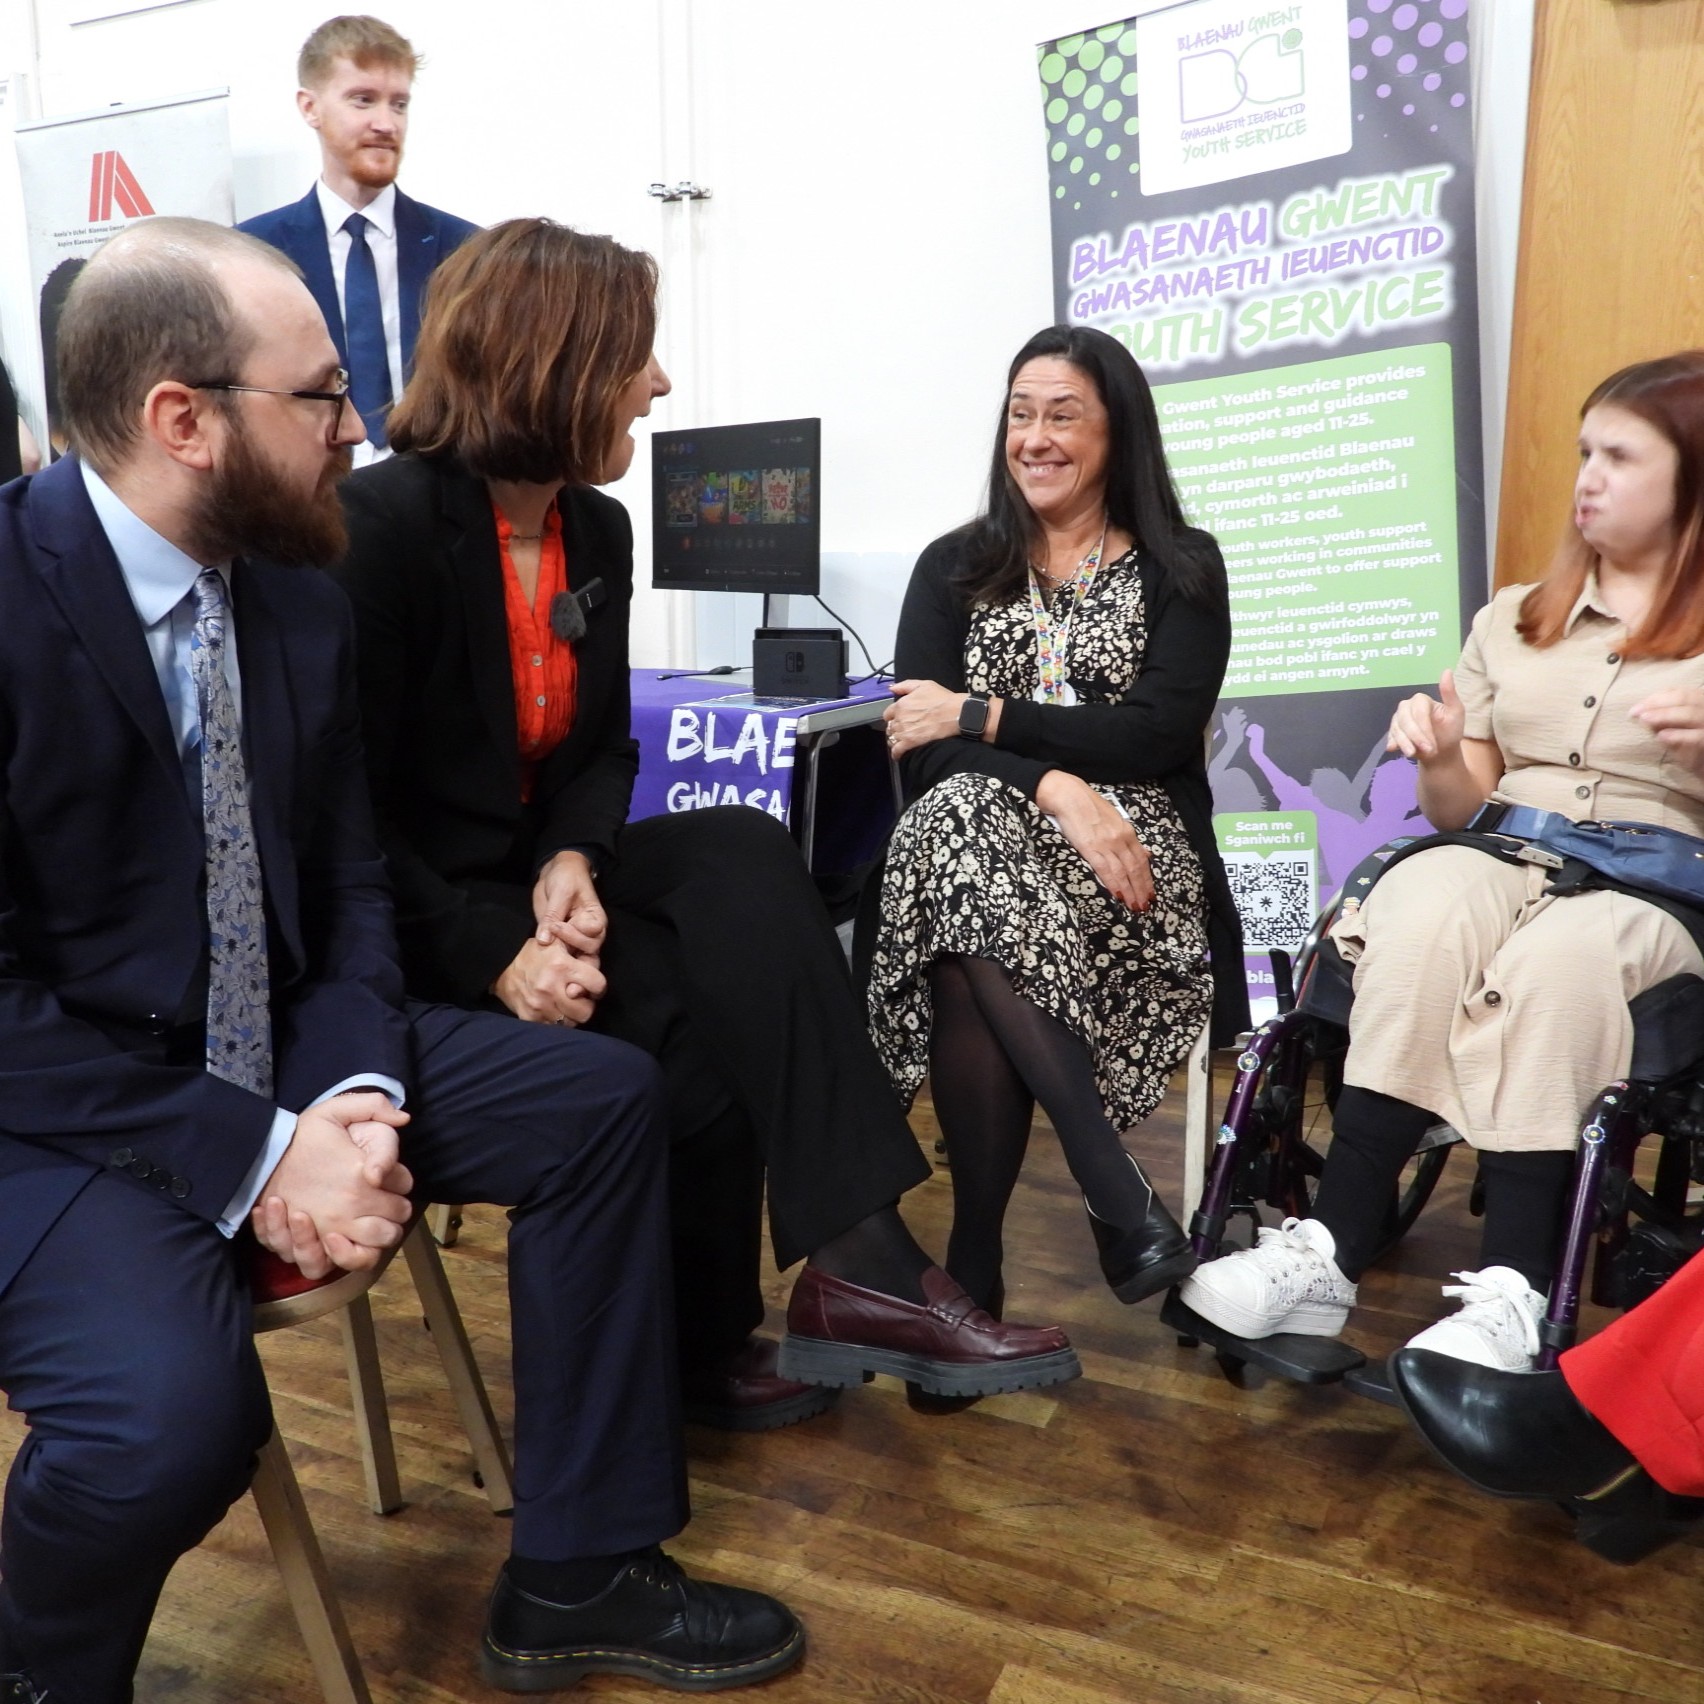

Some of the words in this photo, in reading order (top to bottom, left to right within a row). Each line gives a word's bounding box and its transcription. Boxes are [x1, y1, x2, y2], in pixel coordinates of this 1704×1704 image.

[1178, 20, 1244, 51] BLAENAU
[1248, 6, 1302, 34] GWENT
[1180, 116, 1245, 142] GWASANAETH
[1248, 102, 1306, 126] IEUENCTID
[1182, 136, 1231, 164] YOUTH
[1235, 118, 1307, 149] SERVICE
[1072, 207, 1267, 284] BLAENAU
[1282, 170, 1448, 238] GWENT
[1073, 256, 1270, 319] GWASANAETH
[1282, 226, 1444, 281] IEUENCTID
[1109, 308, 1223, 362] OUTH
[1238, 270, 1444, 348] SERVICE
[1162, 397, 1218, 415] Gwent
[1222, 388, 1272, 407] Youth
[1276, 378, 1341, 398] Service
[1346, 366, 1426, 390] provides
[1160, 418, 1210, 434] ation,
[1214, 406, 1282, 427] support
[1286, 400, 1320, 417] and
[1323, 388, 1409, 414] guidance
[1218, 428, 1276, 449] people
[1280, 418, 1325, 438] aged
[1328, 412, 1374, 430] 11-25.
[1170, 458, 1248, 478] asanaeth
[1252, 444, 1335, 468] Ieuenctid
[1340, 436, 1415, 456] Blaenau
[1181, 484, 1202, 498] yn
[1206, 475, 1273, 493] darparu
[1278, 457, 1396, 487] gwybodaeth,
[1205, 493, 1278, 514] cymorth
[1282, 491, 1303, 503] ac
[1307, 476, 1396, 500] arweiniad
[1401, 473, 1407, 488] i
[1215, 516, 1256, 532] ifanc
[1260, 510, 1300, 526] 11-25
[1304, 504, 1343, 522] oed.
[1258, 535, 1320, 550] workers,
[1323, 528, 1365, 545] youth
[1368, 521, 1427, 538] support
[1224, 558, 1254, 569] eers
[1256, 551, 1316, 565] working
[1319, 548, 1332, 559] in
[1336, 536, 1433, 557] communities
[1228, 570, 1272, 583] laenau
[1276, 565, 1322, 579] Gwent
[1325, 563, 1341, 574] to
[1344, 560, 1380, 573] offer
[1383, 552, 1442, 569] support
[1229, 588, 1262, 599] oung
[1266, 582, 1318, 598] people.
[1230, 610, 1273, 622] ithwyr
[1277, 602, 1344, 617] ieuenctid
[1348, 597, 1412, 613] cymwys,
[1231, 622, 1294, 637] euenctid
[1297, 624, 1305, 632] a
[1309, 614, 1416, 633] gwirfoddolwyr
[1420, 611, 1439, 623] yn
[1231, 640, 1284, 652] unedau
[1288, 639, 1304, 648] ac
[1308, 632, 1368, 649] ysgolion
[1372, 632, 1388, 641] ar
[1391, 628, 1437, 640] draws
[1256, 654, 1283, 667] bod
[1287, 651, 1317, 666] pobl
[1321, 650, 1357, 661] ifanc
[1360, 649, 1379, 661] yn
[1383, 644, 1413, 656] cael
[1416, 644, 1426, 656] y
[1224, 672, 1250, 686] ydd
[1254, 670, 1267, 682] ei
[1270, 668, 1314, 682] angen
[667, 782, 790, 823] GWASA
[1225, 833, 1291, 847] Sganiwch
[1294, 832, 1305, 843] fi
[1235, 822, 1268, 831] Scan
[1272, 821, 1293, 830] me
